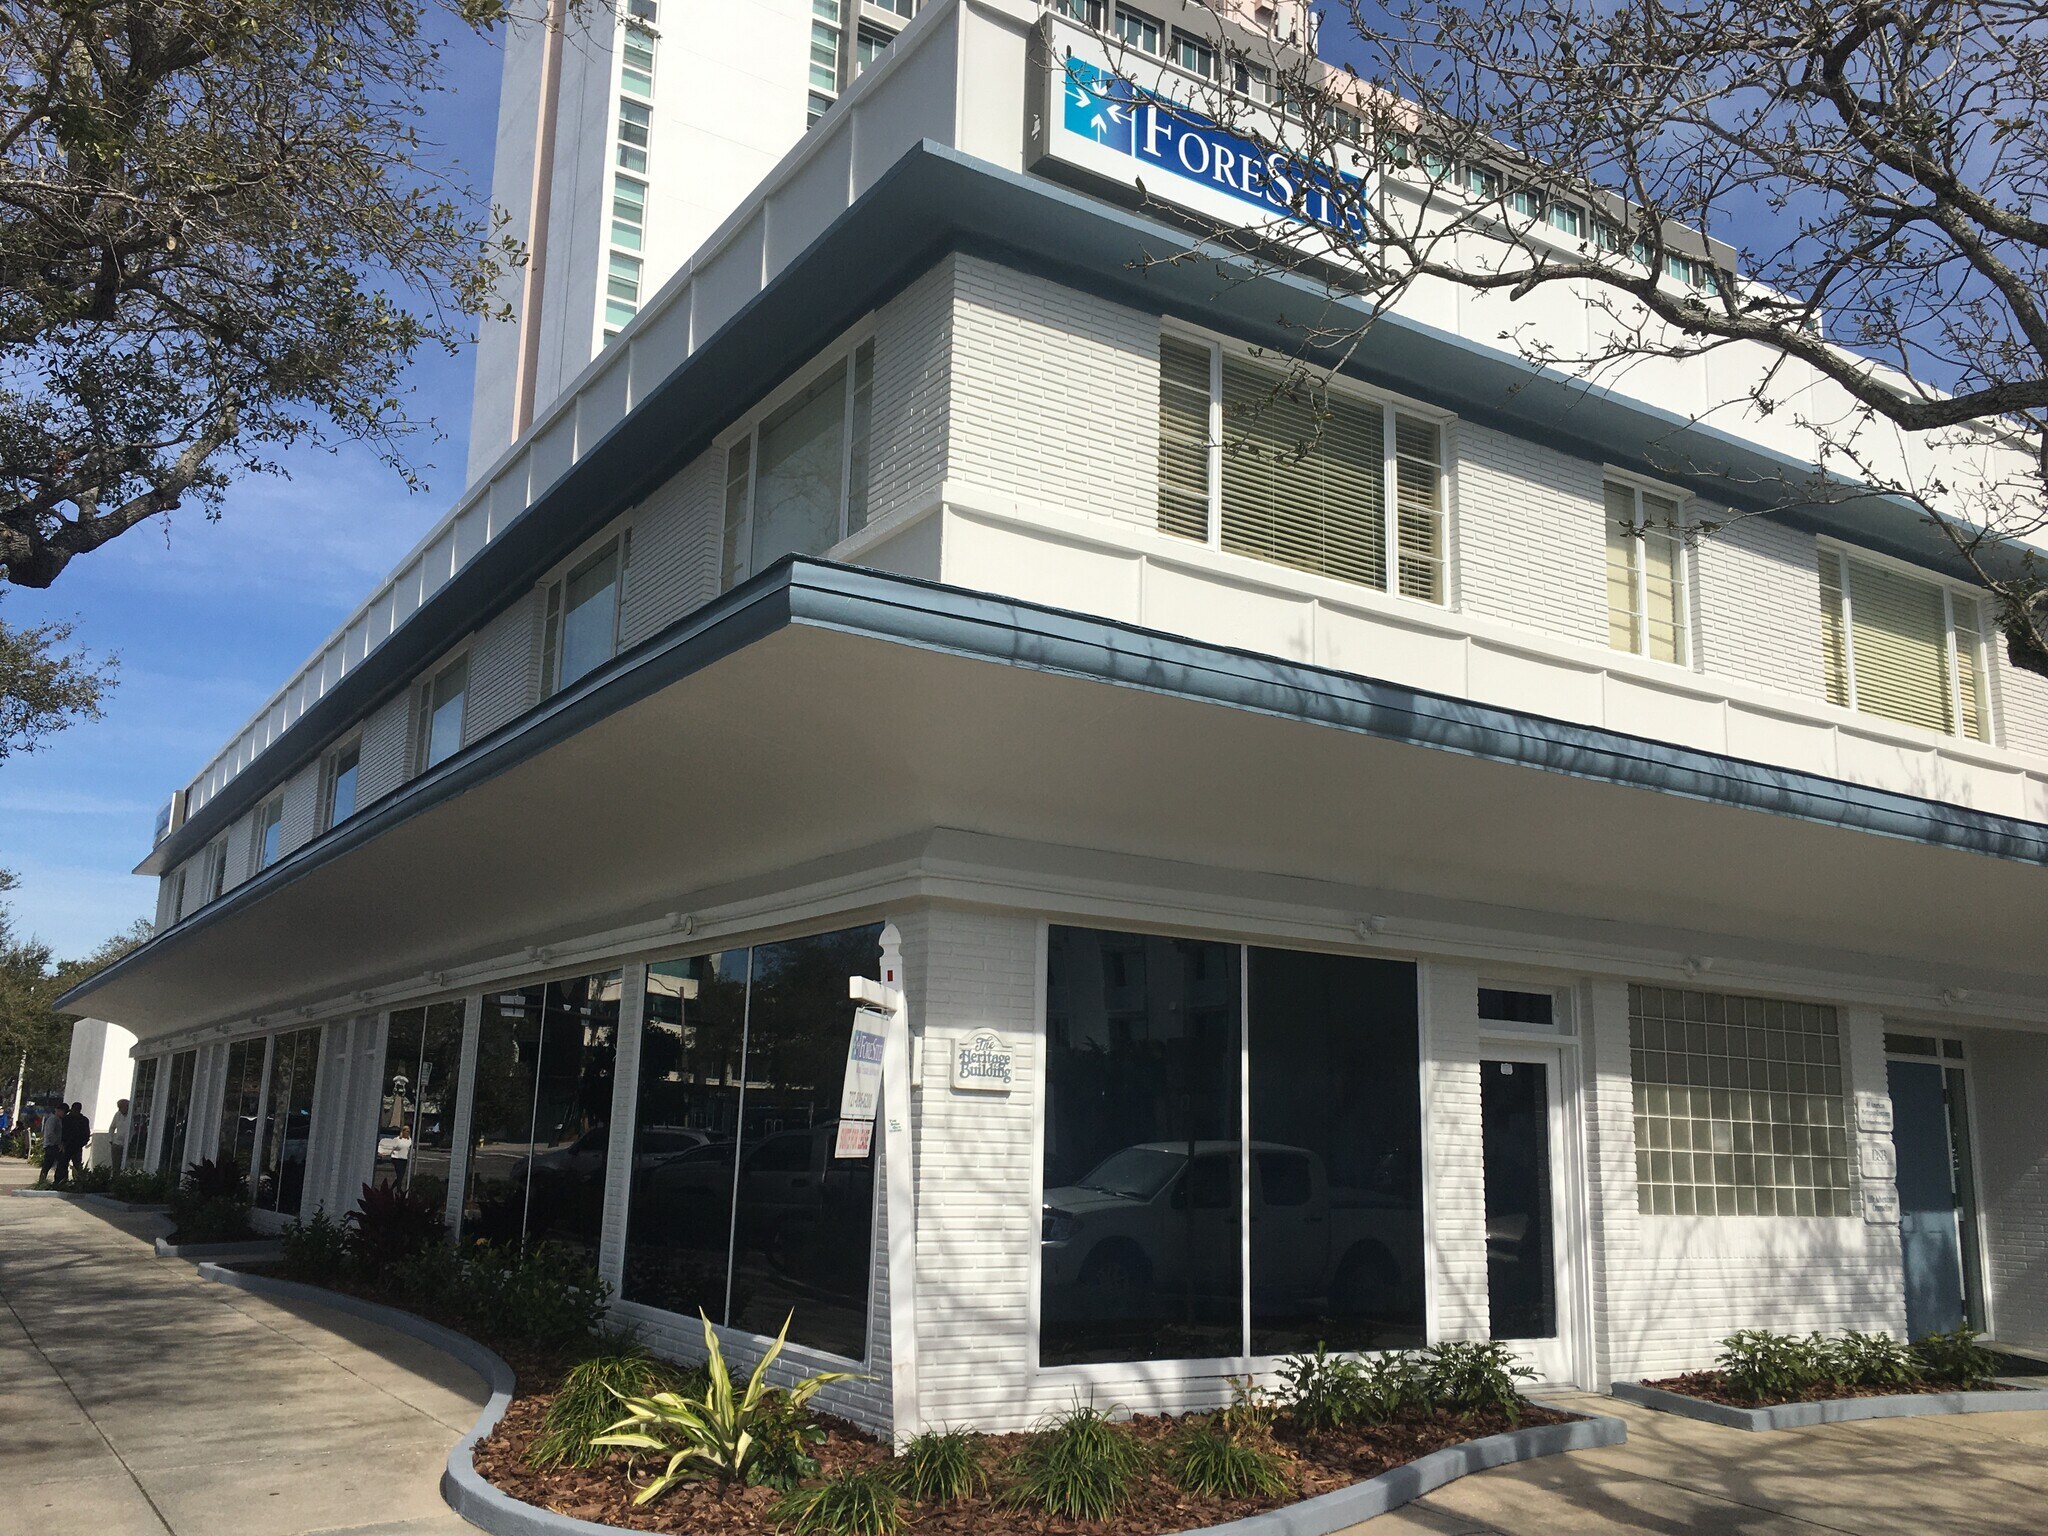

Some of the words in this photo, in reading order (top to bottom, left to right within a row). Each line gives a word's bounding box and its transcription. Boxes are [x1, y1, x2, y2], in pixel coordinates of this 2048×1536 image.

[975, 1036, 996, 1052] The
[959, 1049, 1011, 1067] Heritage
[959, 1063, 1012, 1084] Building
